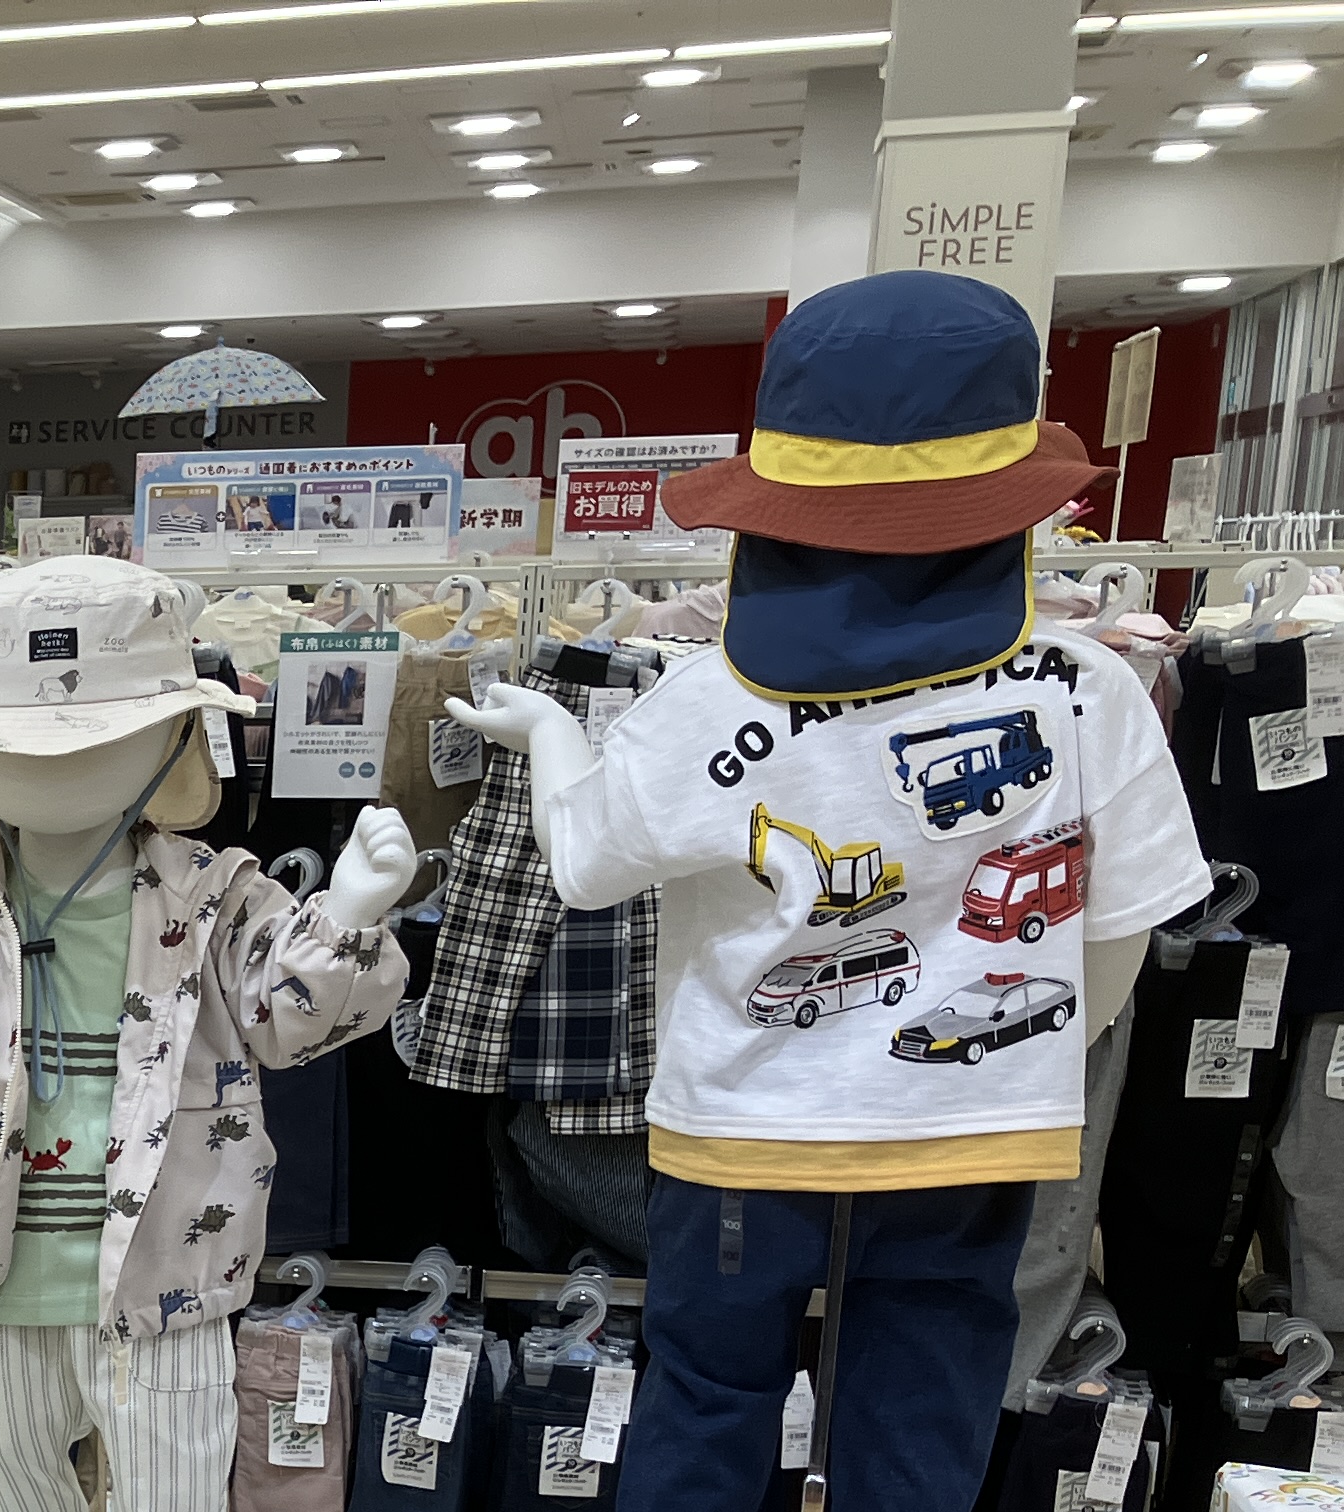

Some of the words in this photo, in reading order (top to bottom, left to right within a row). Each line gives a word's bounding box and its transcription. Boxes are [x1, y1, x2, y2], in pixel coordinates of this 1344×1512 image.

[919, 236, 1014, 267] FREE
[38, 420, 156, 444] SERVICE
[570, 481, 653, 496] 旧モデルのため
[460, 508, 523, 529] 新学期
[573, 495, 645, 519] お買得
[707, 721, 775, 789] GO
